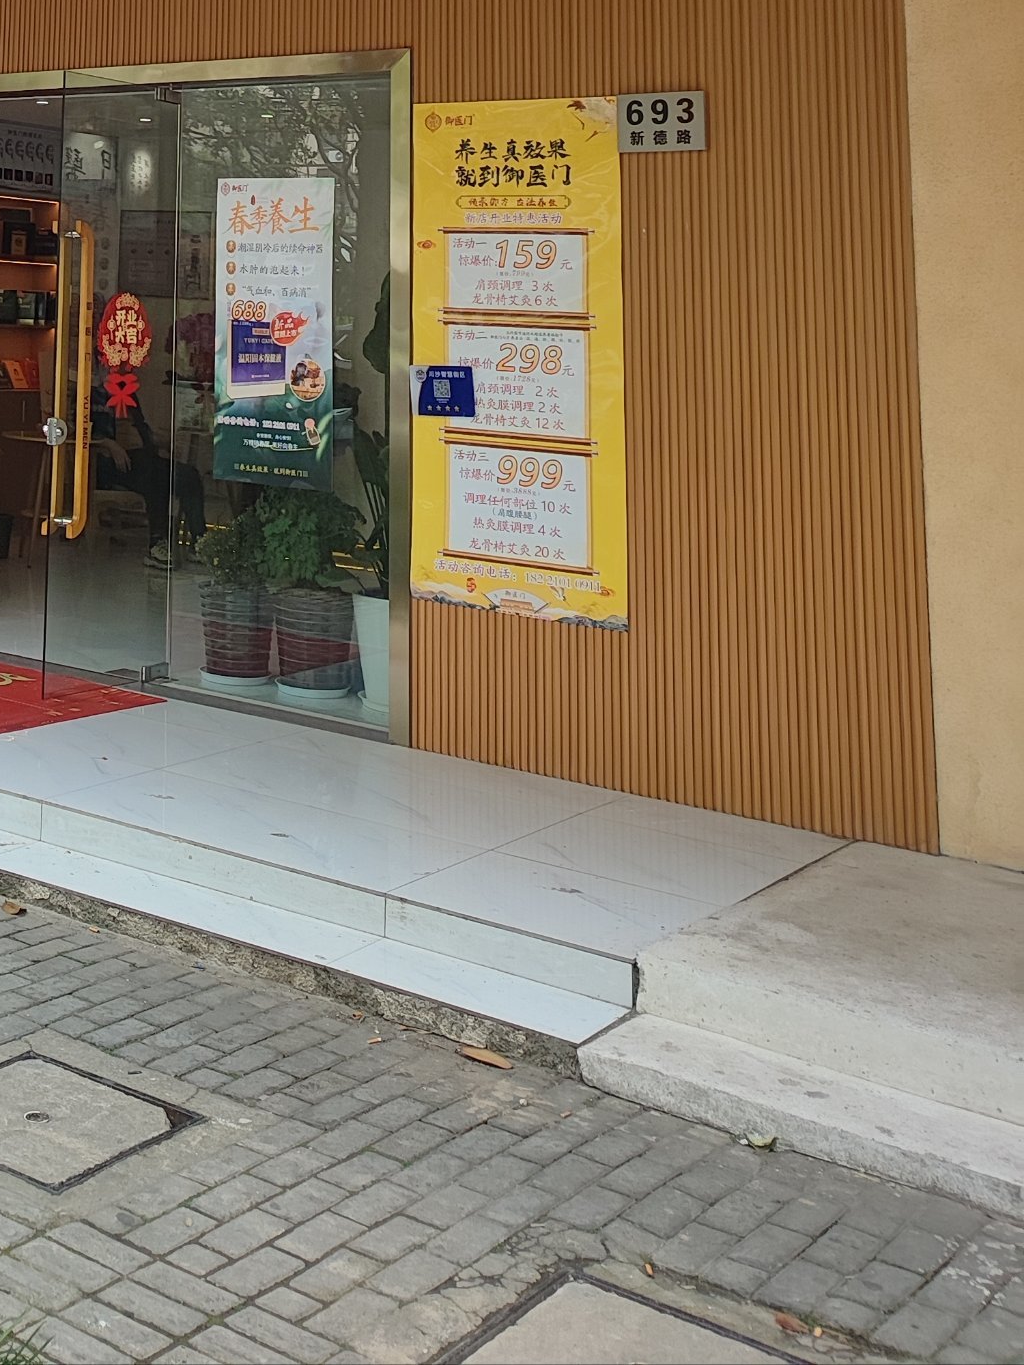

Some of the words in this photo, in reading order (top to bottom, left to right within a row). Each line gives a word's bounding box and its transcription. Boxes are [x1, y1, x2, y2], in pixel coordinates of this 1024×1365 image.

[445, 115, 473, 127] 御医门
[626, 97, 695, 125] 693
[630, 129, 692, 146] 新德路
[455, 138, 571, 163] 养生真效果
[455, 164, 572, 187] 就到御医门
[223, 195, 320, 236] 春季養生
[465, 212, 563, 226] 新店开业特惠活动
[495, 239, 557, 270] 159
[232, 299, 267, 322] 688
[496, 342, 563, 376] 298
[496, 454, 563, 490] 999
